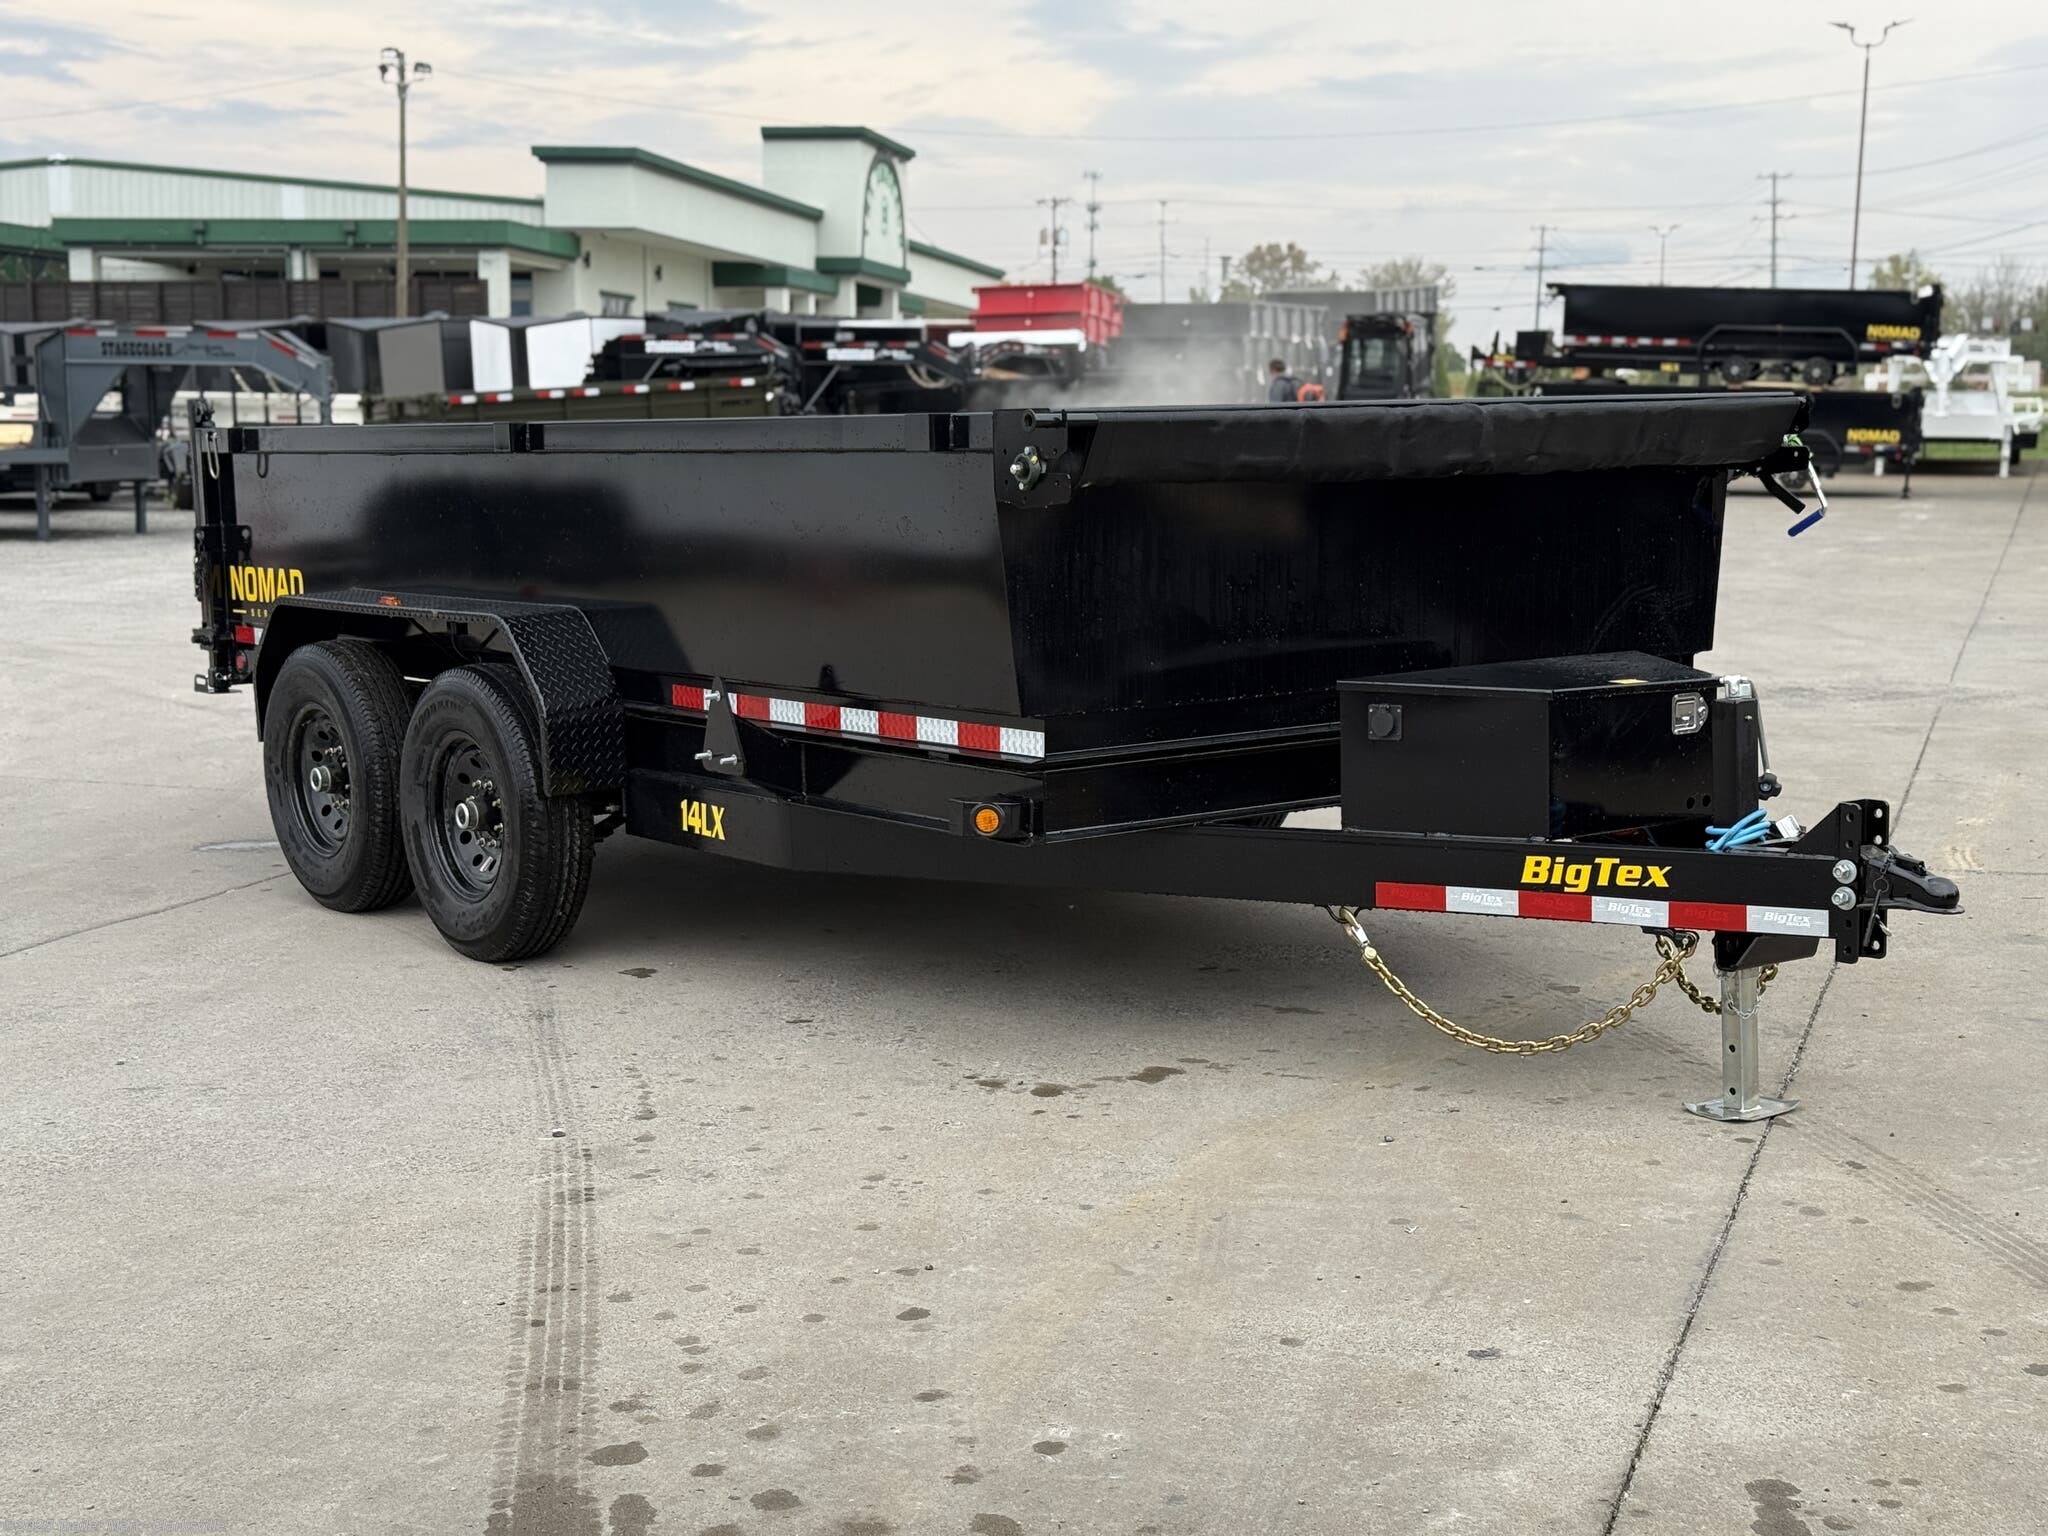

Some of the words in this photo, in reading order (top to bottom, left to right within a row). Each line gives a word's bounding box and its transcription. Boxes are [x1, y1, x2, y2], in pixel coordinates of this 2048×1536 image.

[1867, 325, 1921, 341] NOMAD
[101, 342, 173, 357] STAGECOACH
[1847, 429, 1901, 444] NOMAD
[229, 565, 304, 603] NOMAD
[680, 798, 726, 841] 14LX
[1520, 855, 1673, 893] BigTex
[1461, 892, 1504, 905] BigTex
[1607, 902, 1654, 915] BigTex
[1763, 911, 1812, 926] BigTex
